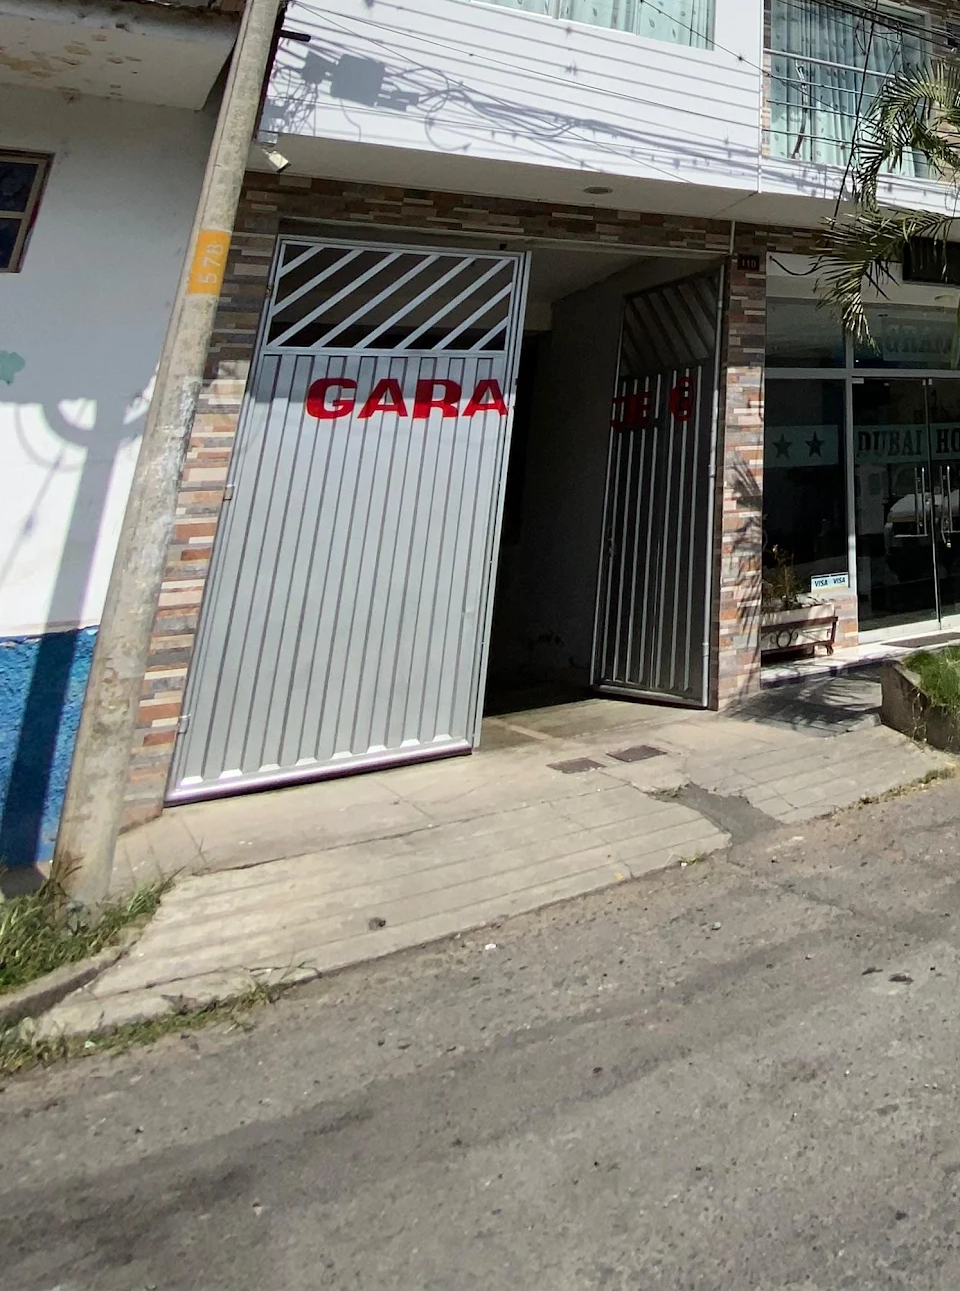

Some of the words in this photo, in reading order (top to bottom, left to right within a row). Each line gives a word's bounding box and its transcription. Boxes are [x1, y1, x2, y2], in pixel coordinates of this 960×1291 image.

[198, 244, 224, 284] 578
[306, 377, 508, 419] GARA
[857, 429, 922, 456] DUBAI
[814, 579, 828, 587] VISA
